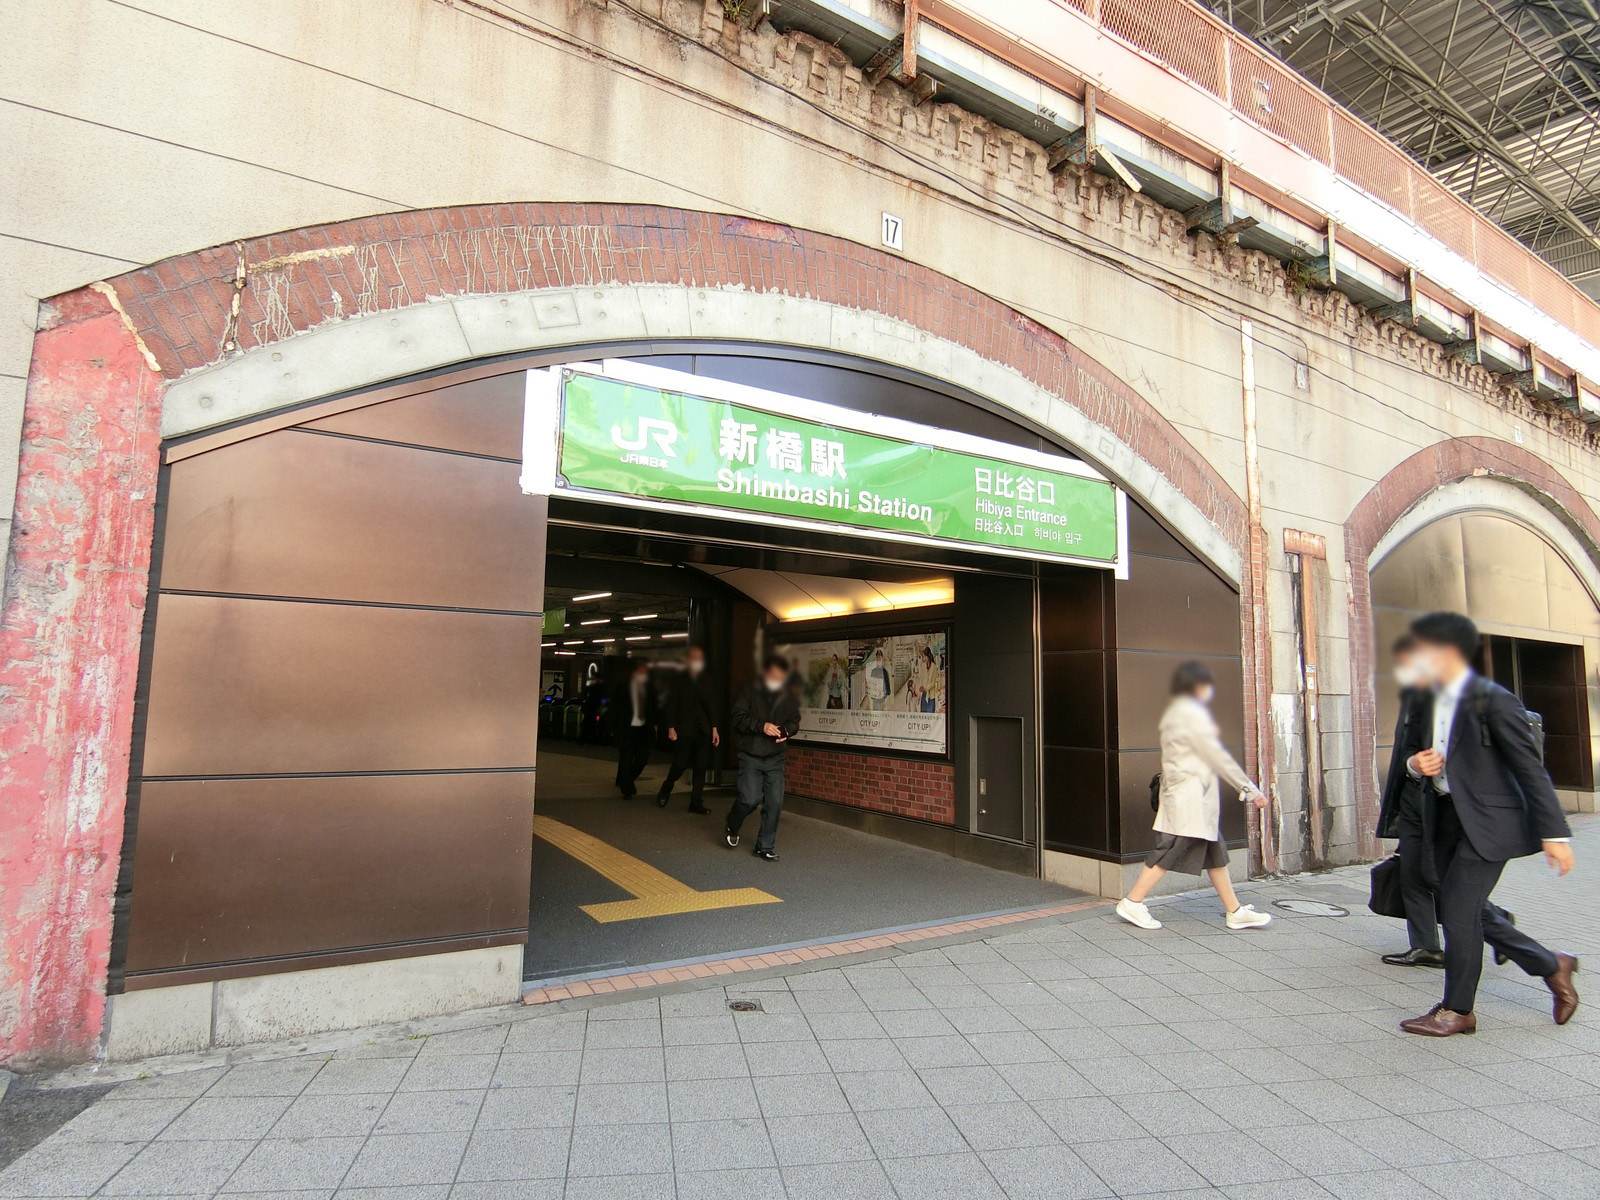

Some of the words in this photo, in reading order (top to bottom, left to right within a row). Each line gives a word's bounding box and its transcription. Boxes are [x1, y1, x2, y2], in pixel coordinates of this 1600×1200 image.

[884, 218, 899, 244] 17
[610, 416, 678, 458] JR
[719, 418, 847, 480] 新橋駅
[717, 467, 850, 509] Shimbashi
[858, 490, 932, 522] Station
[974, 467, 1055, 506] 日比谷口
[975, 497, 1012, 520] Hibiya
[1016, 504, 1067, 527] Entrance
[974, 517, 1023, 536] 日比谷入口
[1033, 527, 1061, 542] 히비야
[1064, 531, 1083, 546] 입구
[860, 719, 871, 727] CITY
[907, 722, 920, 730] CITY
